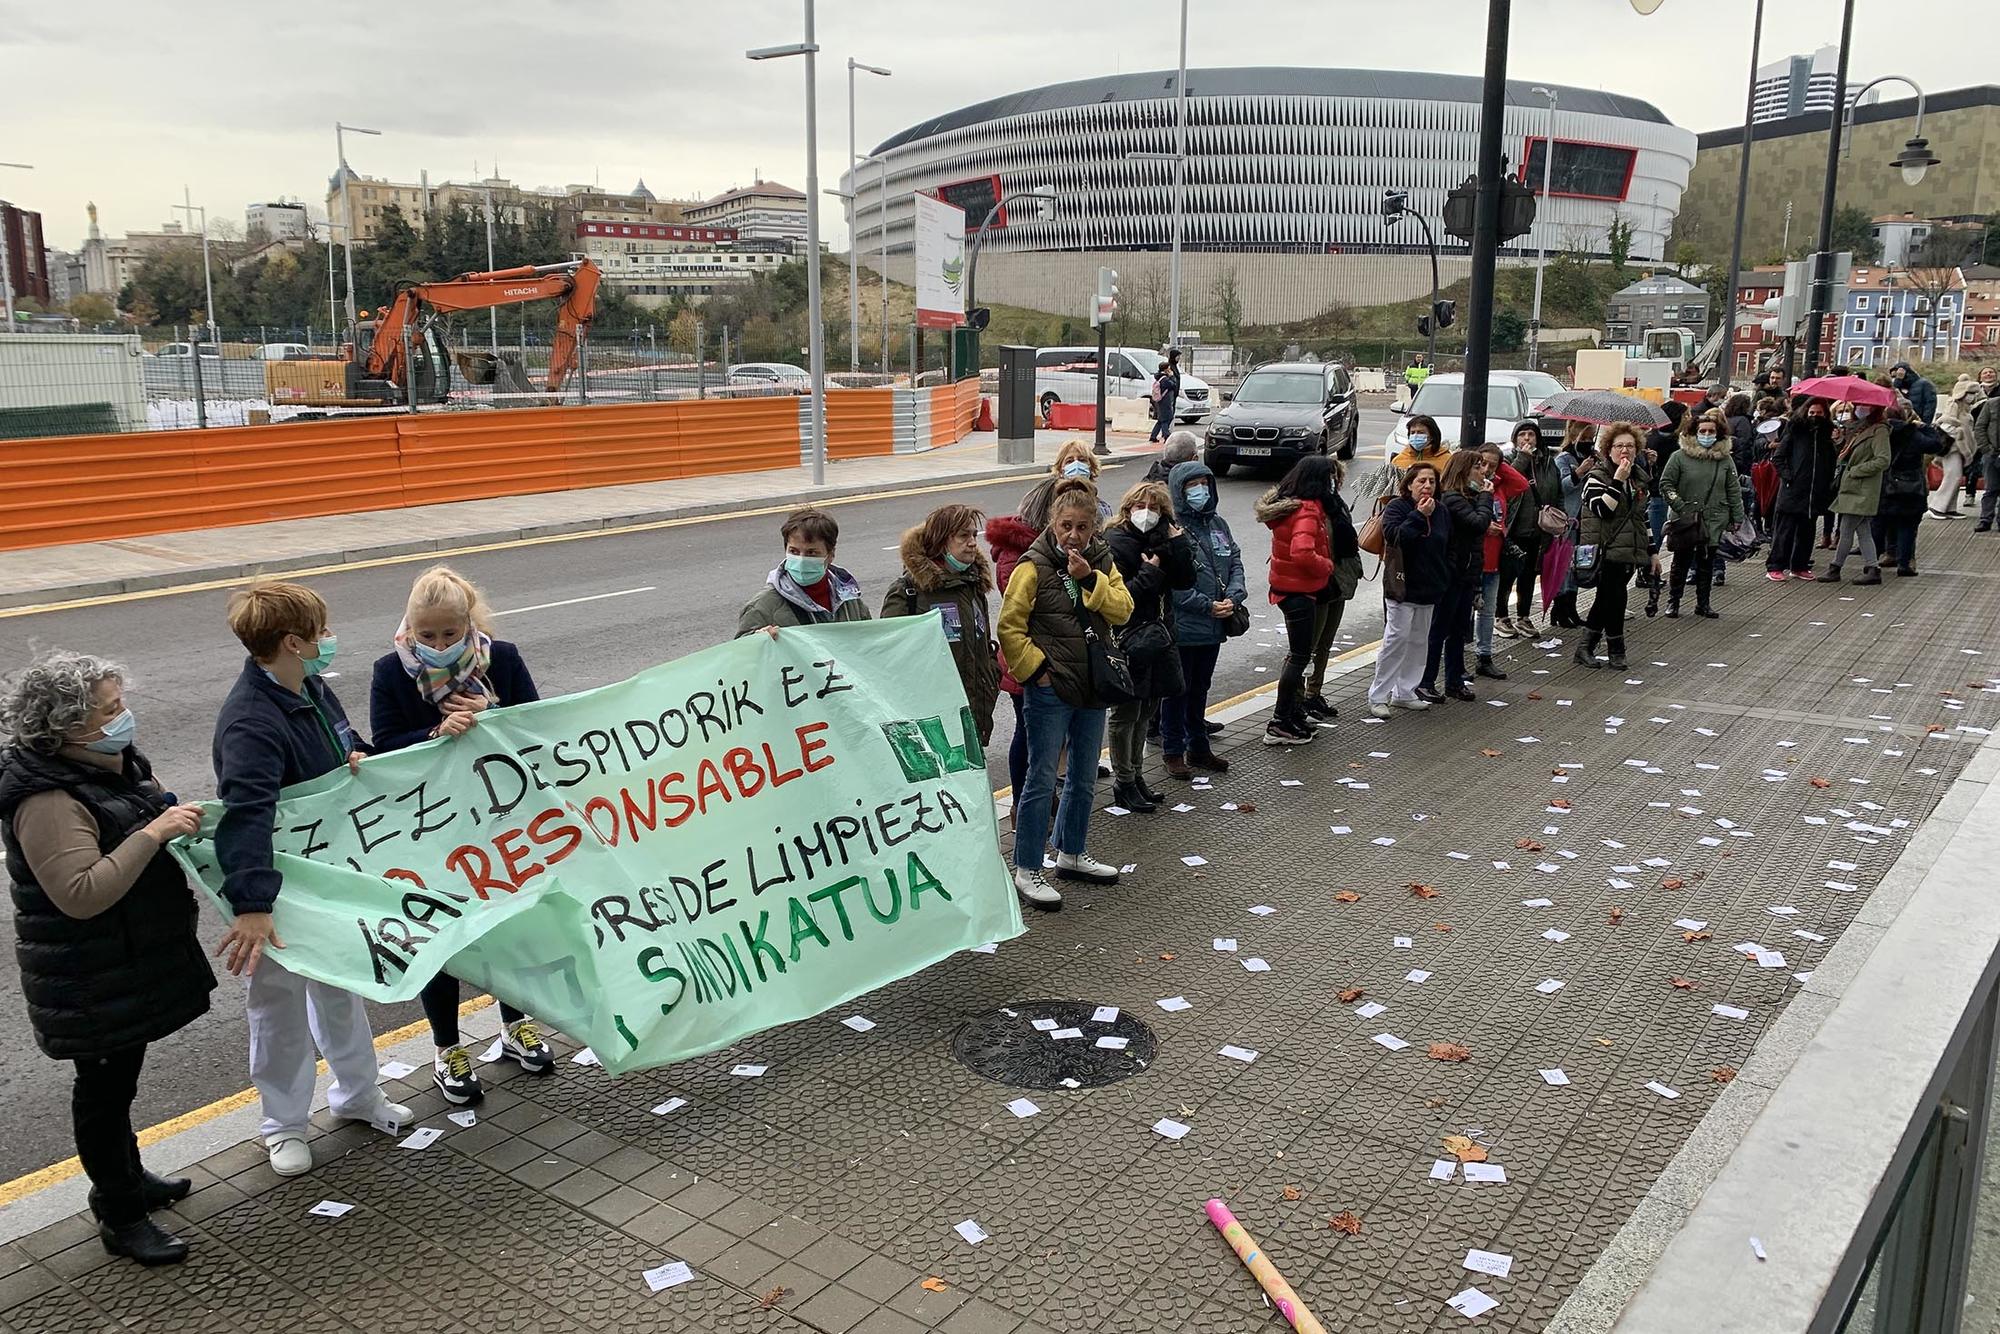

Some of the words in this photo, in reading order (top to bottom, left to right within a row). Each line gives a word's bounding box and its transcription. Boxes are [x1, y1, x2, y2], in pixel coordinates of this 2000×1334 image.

[504, 287, 538, 296] HITACHI
[273, 818, 329, 859] Z
[781, 660, 854, 708] EZ
[446, 721, 836, 900] RESONSABLE
[747, 790, 968, 896] LIMPIEZA
[637, 851, 952, 1014] SINDIKATUA
